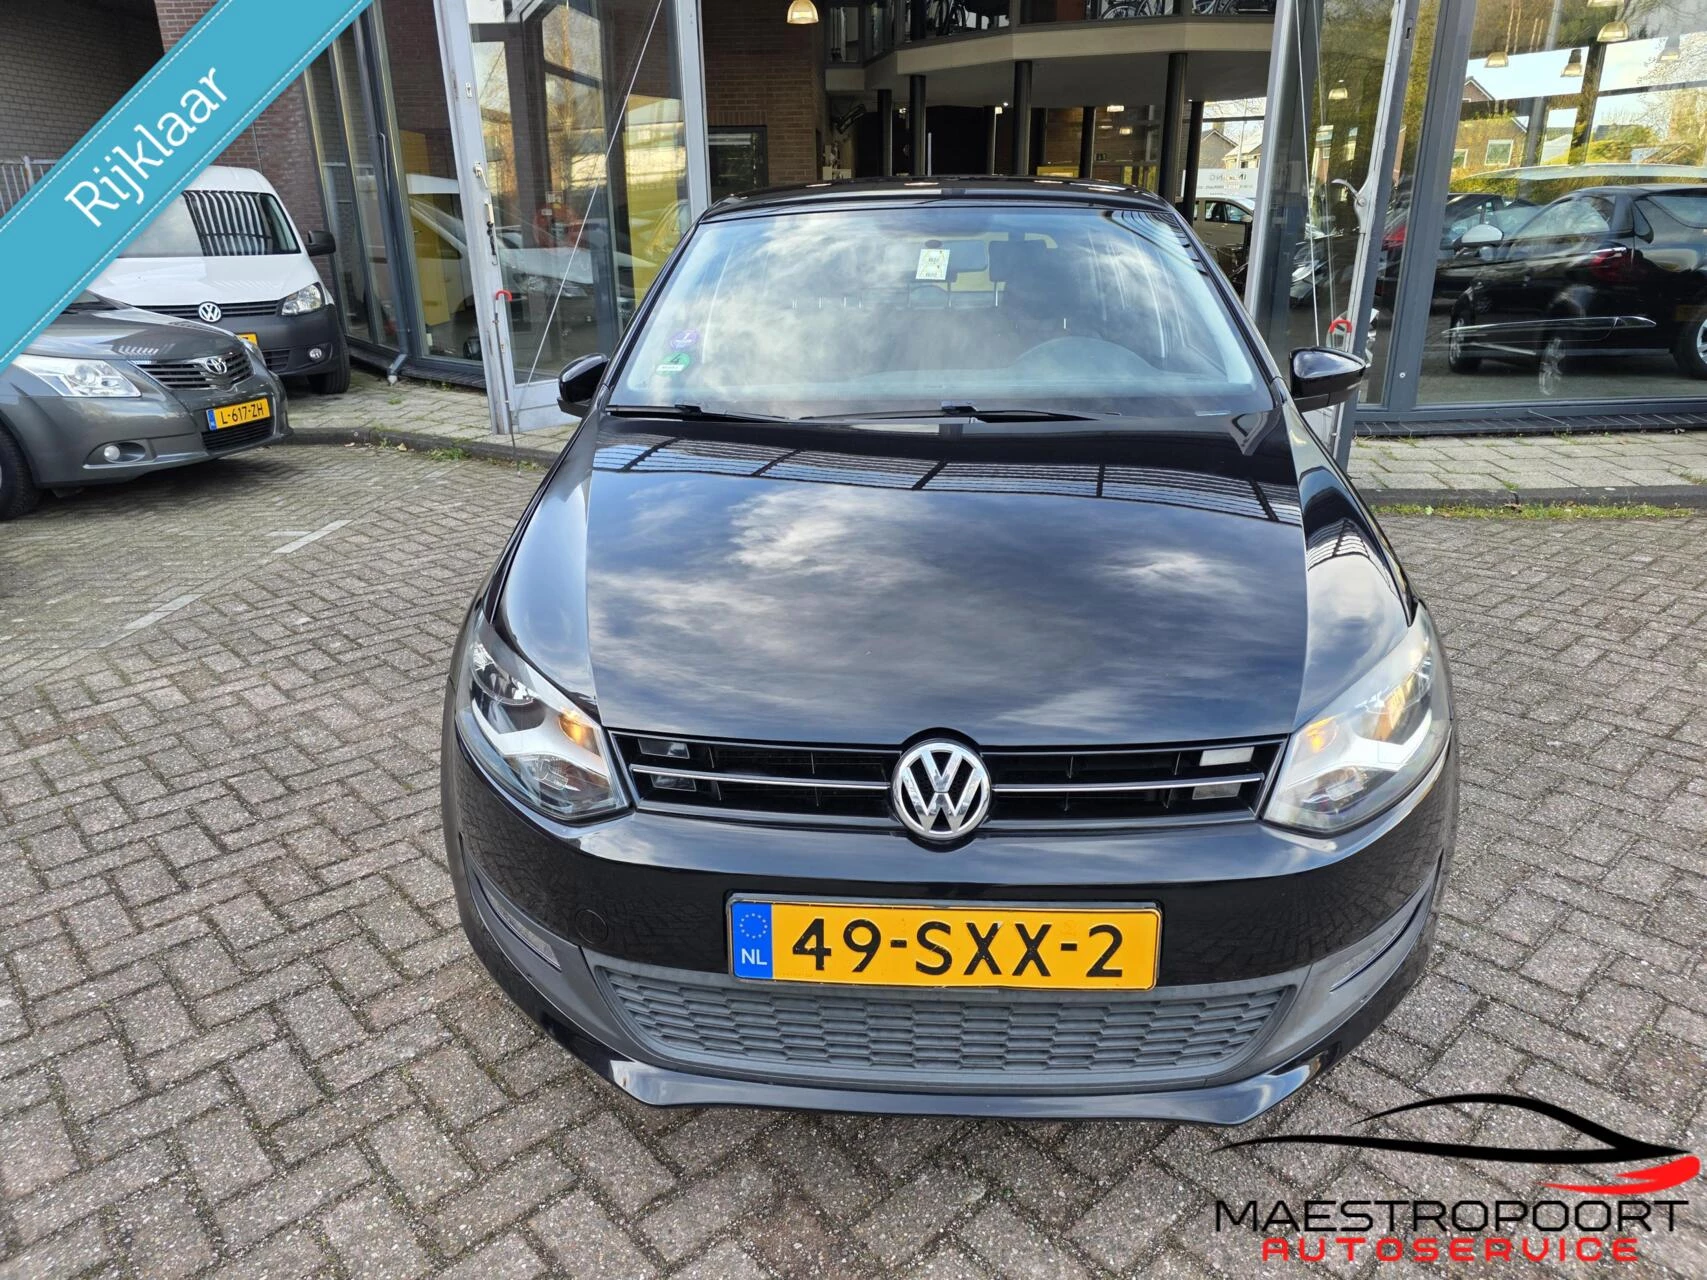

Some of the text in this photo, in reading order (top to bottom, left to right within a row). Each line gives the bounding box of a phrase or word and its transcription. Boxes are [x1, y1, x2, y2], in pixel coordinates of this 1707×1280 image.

[220, 402, 264, 424] L-617-ZH
[741, 949, 768, 966] NL
[792, 917, 1123, 978] 49-SXX-2
